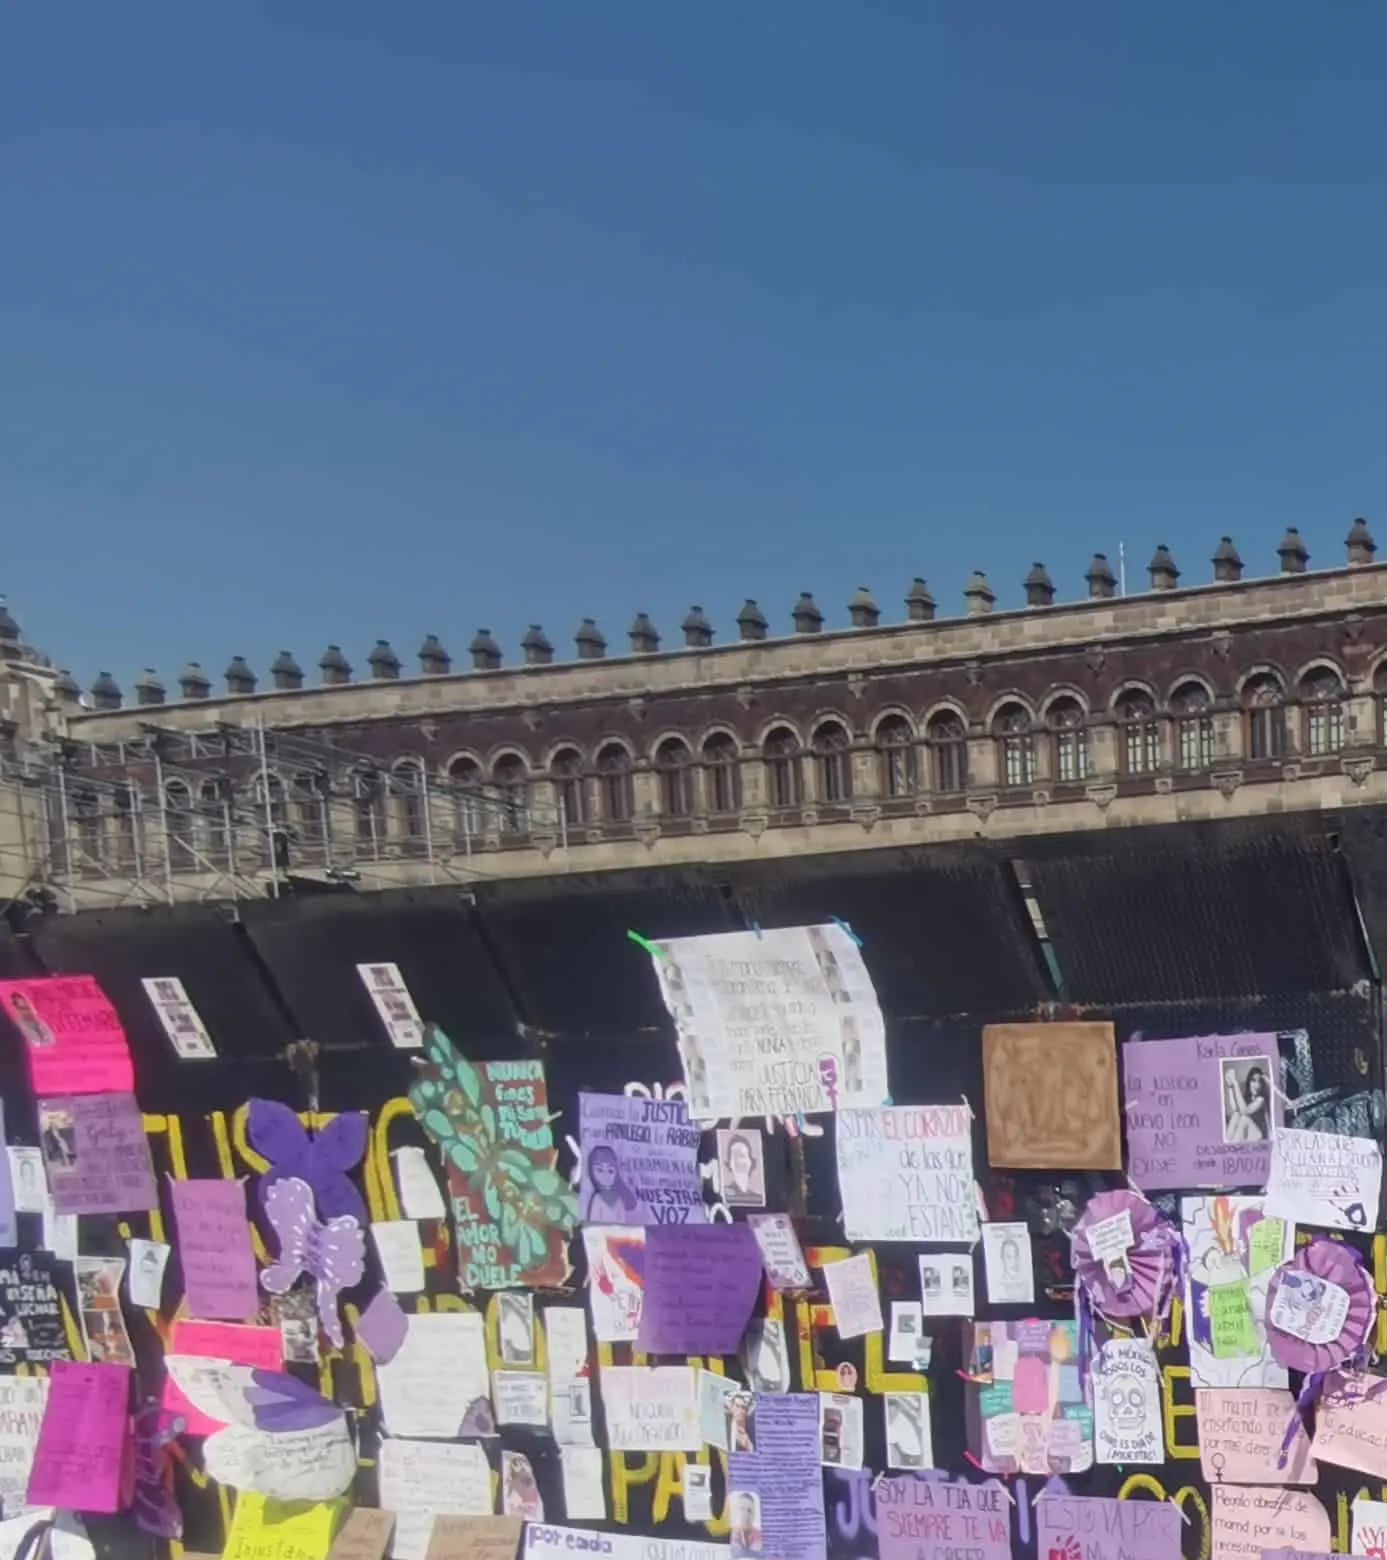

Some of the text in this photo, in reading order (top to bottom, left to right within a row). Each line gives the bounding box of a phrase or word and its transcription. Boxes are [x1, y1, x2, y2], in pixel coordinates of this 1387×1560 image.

[913, 1485, 1002, 1512] LA QUE
[962, 1516, 981, 1539] TE
